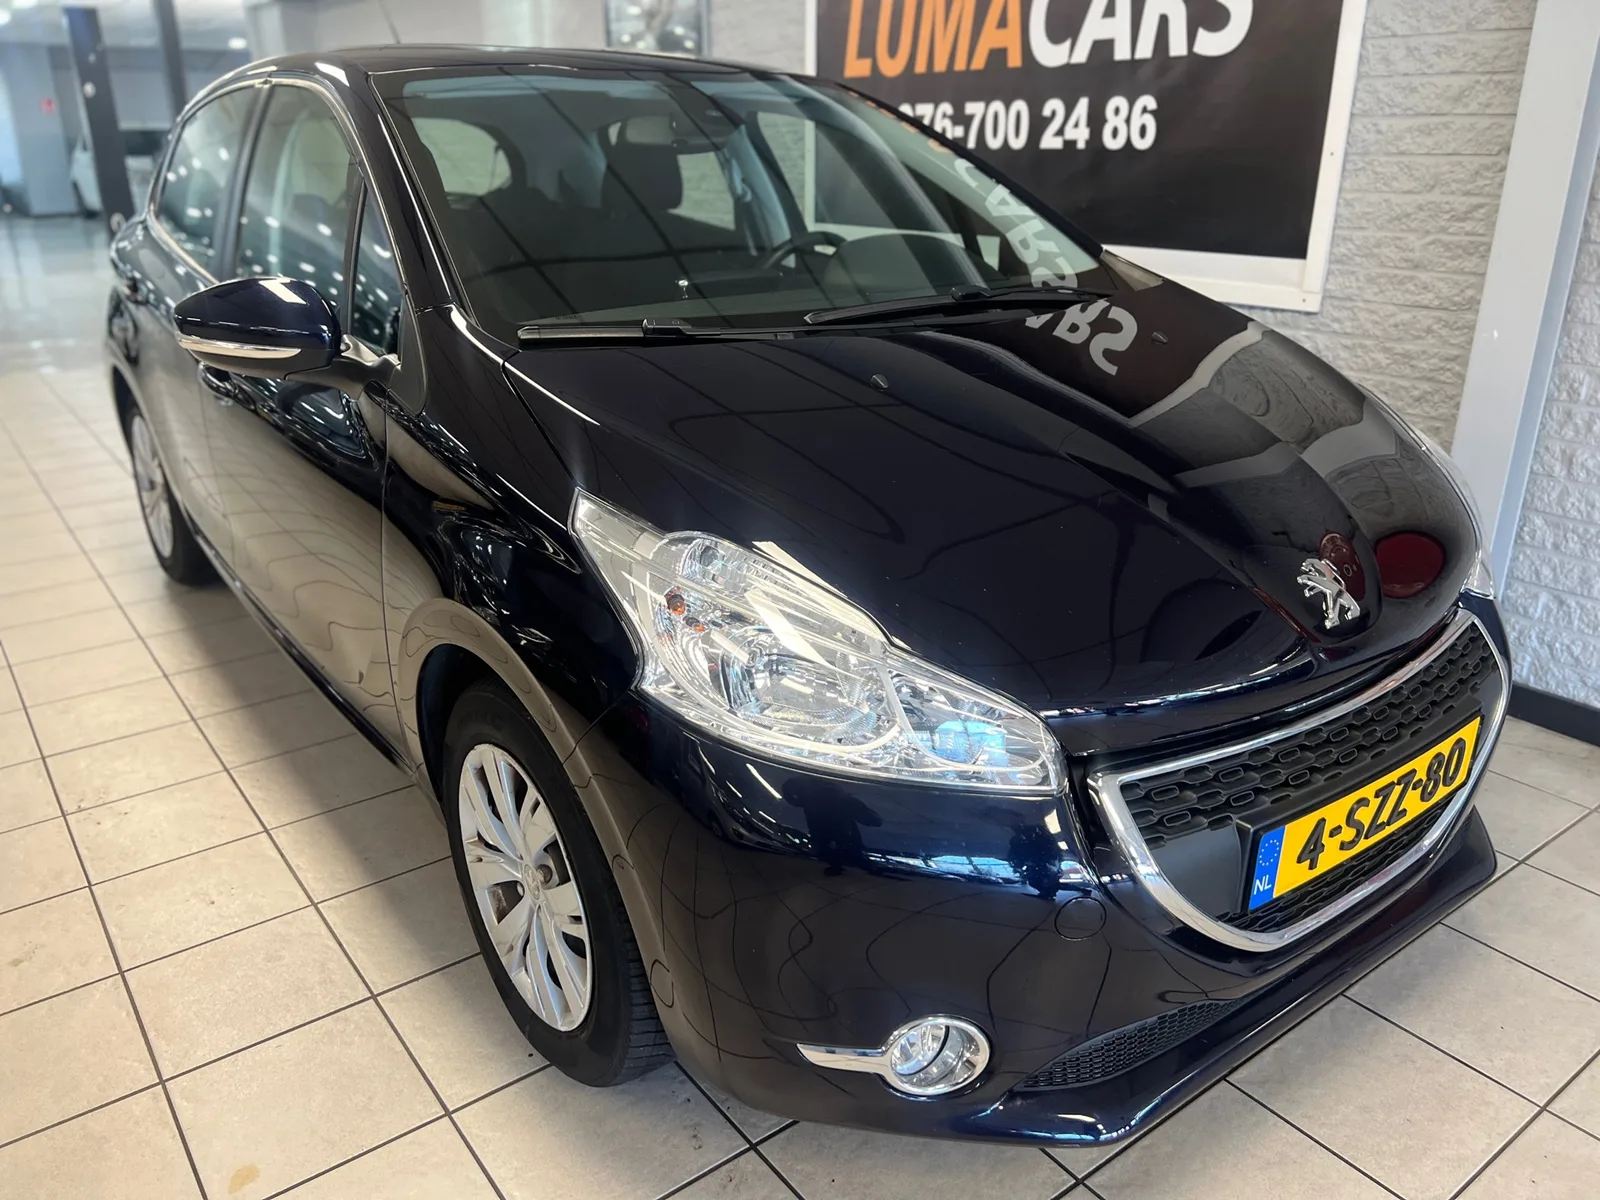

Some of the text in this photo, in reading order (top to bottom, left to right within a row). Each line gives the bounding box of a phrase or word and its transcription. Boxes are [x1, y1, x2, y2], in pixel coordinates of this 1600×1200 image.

[898, 95, 1158, 150] 76-700 24 86
[1296, 737, 1466, 871] 4-SZZ-80
[1253, 874, 1272, 895] NL
